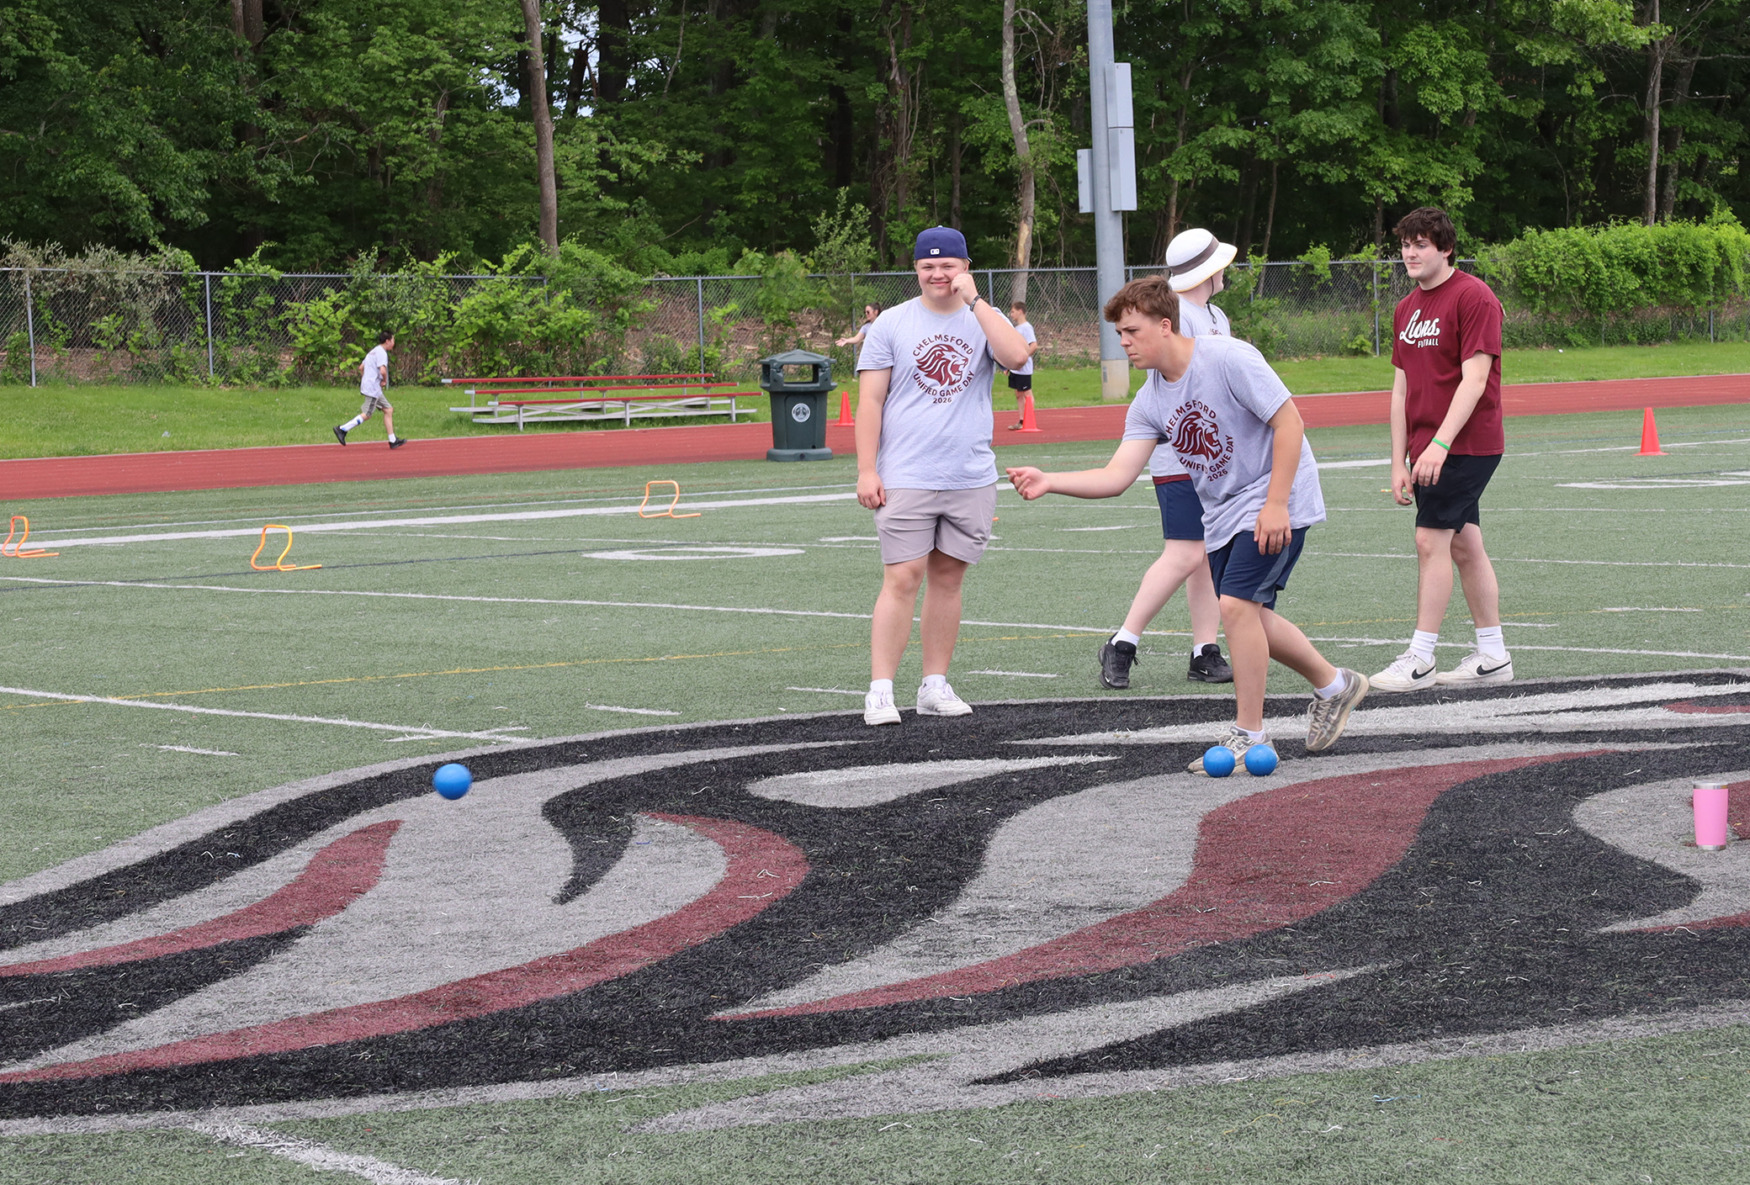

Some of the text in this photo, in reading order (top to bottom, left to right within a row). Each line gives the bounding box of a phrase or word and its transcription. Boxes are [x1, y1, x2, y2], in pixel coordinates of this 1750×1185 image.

[1399, 309, 1440, 344] Lions
[913, 334, 973, 356] CHELMSFORD
[1418, 338, 1438, 348] FOTBALL
[913, 371, 974, 397] UNIFIED GAME DAY
[1210, 454, 1231, 472] GAME
[1225, 435, 1234, 453] DAY
[1208, 469, 1228, 481] 2026
